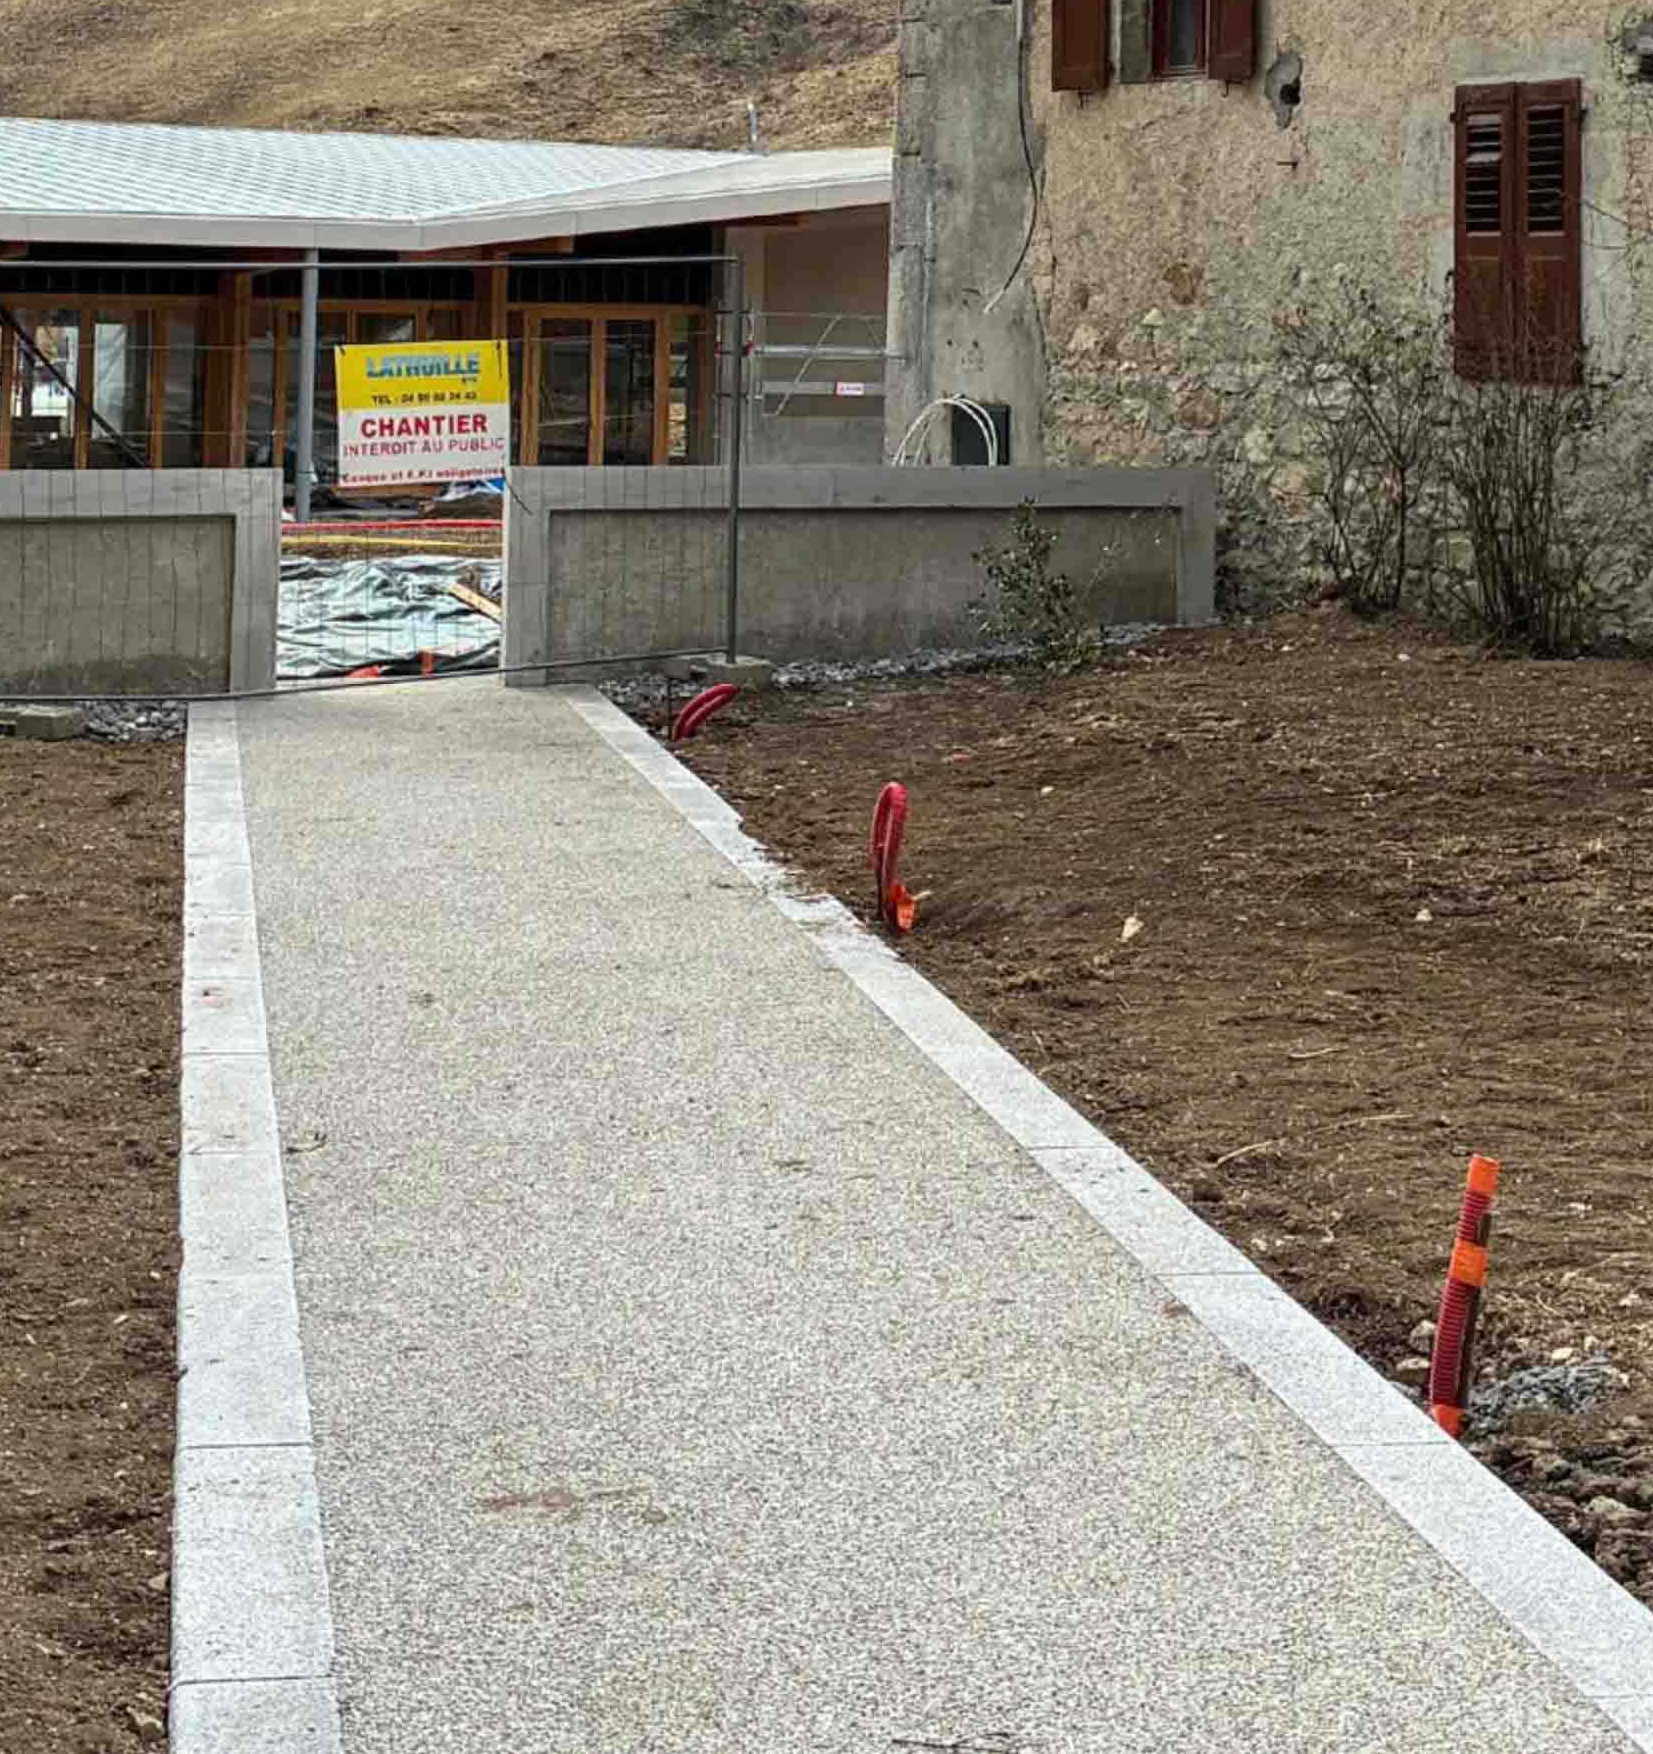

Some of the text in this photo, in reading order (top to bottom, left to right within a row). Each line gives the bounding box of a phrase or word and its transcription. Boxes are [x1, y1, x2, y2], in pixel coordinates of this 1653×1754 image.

[361, 414, 488, 437] CHANTIER
[345, 437, 506, 456] INTERDIT AU PUBLIC
